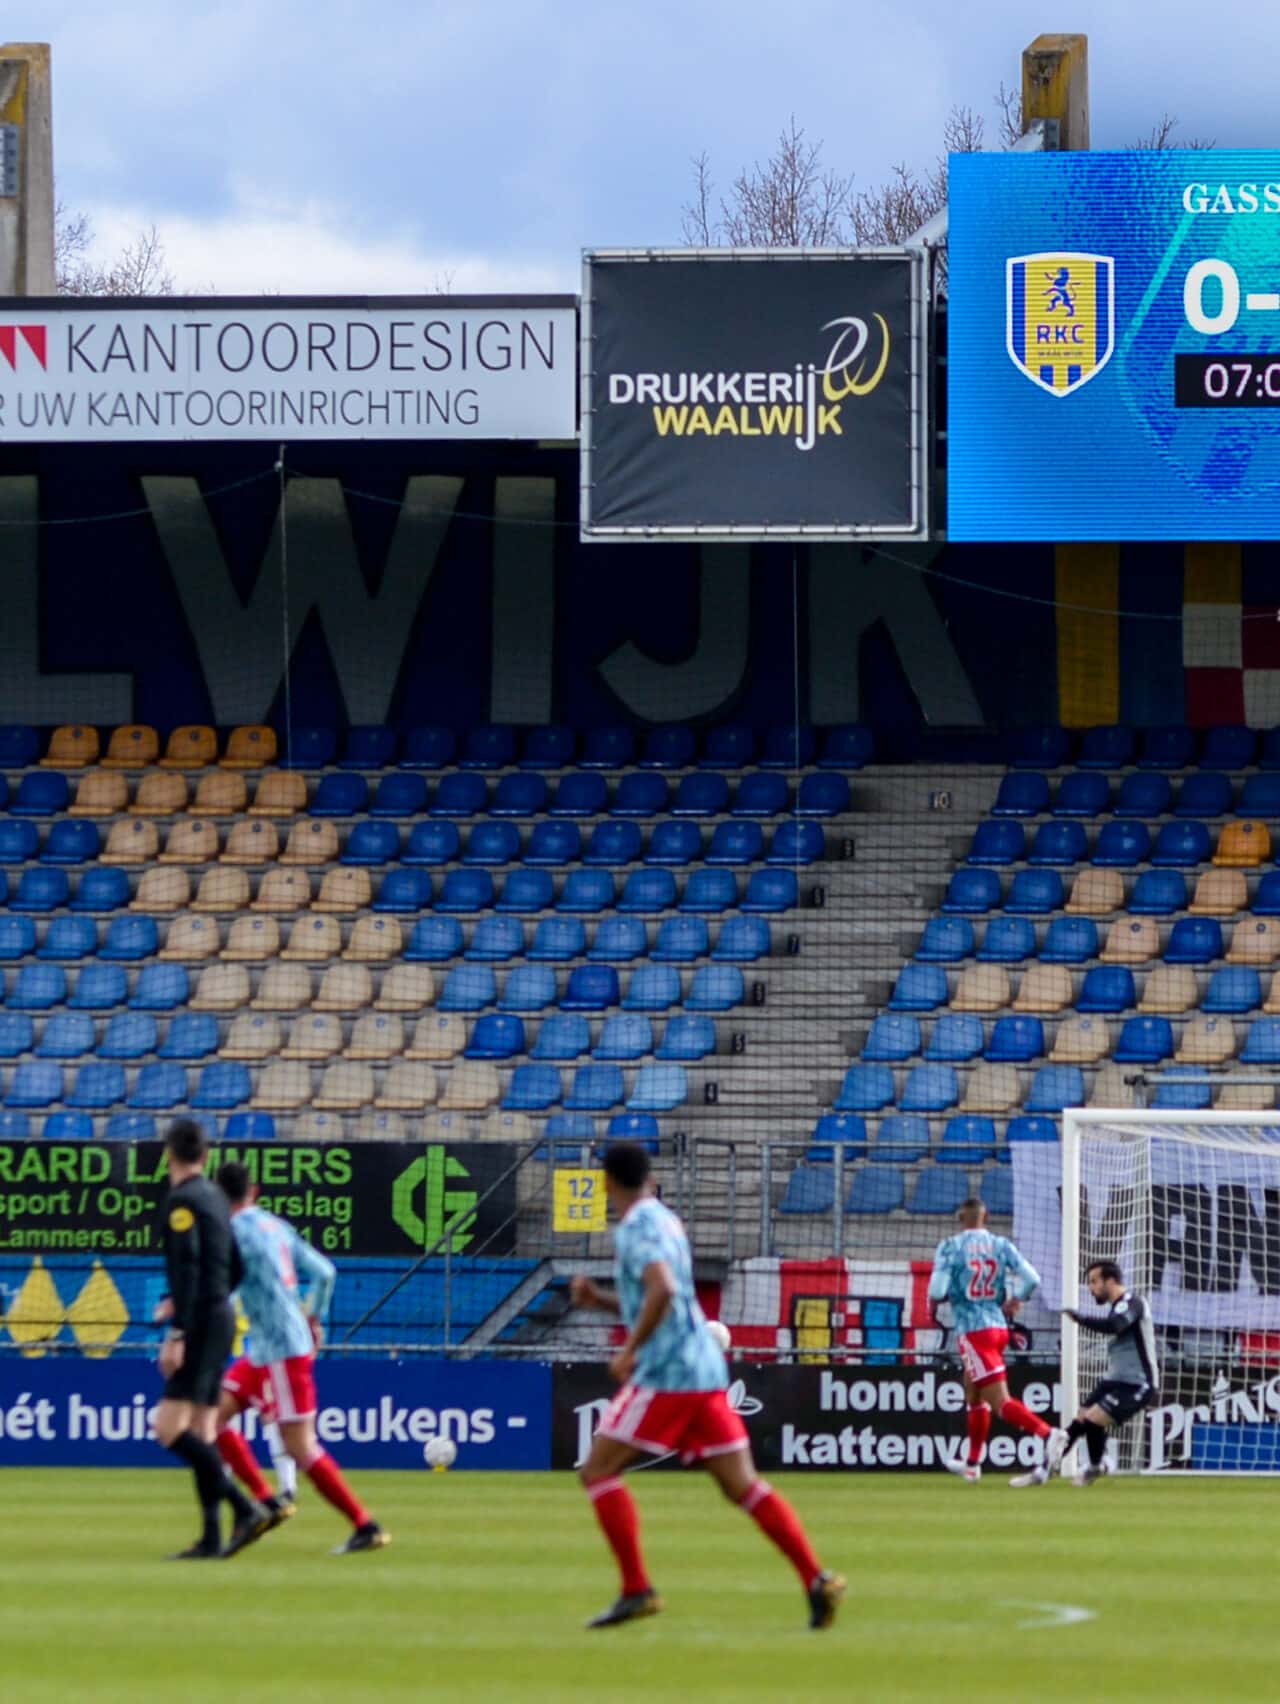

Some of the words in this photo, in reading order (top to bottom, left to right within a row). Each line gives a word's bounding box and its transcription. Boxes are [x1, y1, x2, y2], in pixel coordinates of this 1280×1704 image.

[67, 321, 556, 374] KANTOORDESIGN
[1036, 323, 1086, 345] RKC
[17, 391, 76, 428] UW
[88, 388, 480, 427] KANTOORINRICHTING
[567, 1176, 595, 1199] 12
[0, 1190, 71, 1221] port
[0, 1224, 150, 1248] ammers.nl
[322, 1226, 353, 1250] 61
[968, 1258, 998, 1299] 22
[0, 1392, 56, 1441] ét
